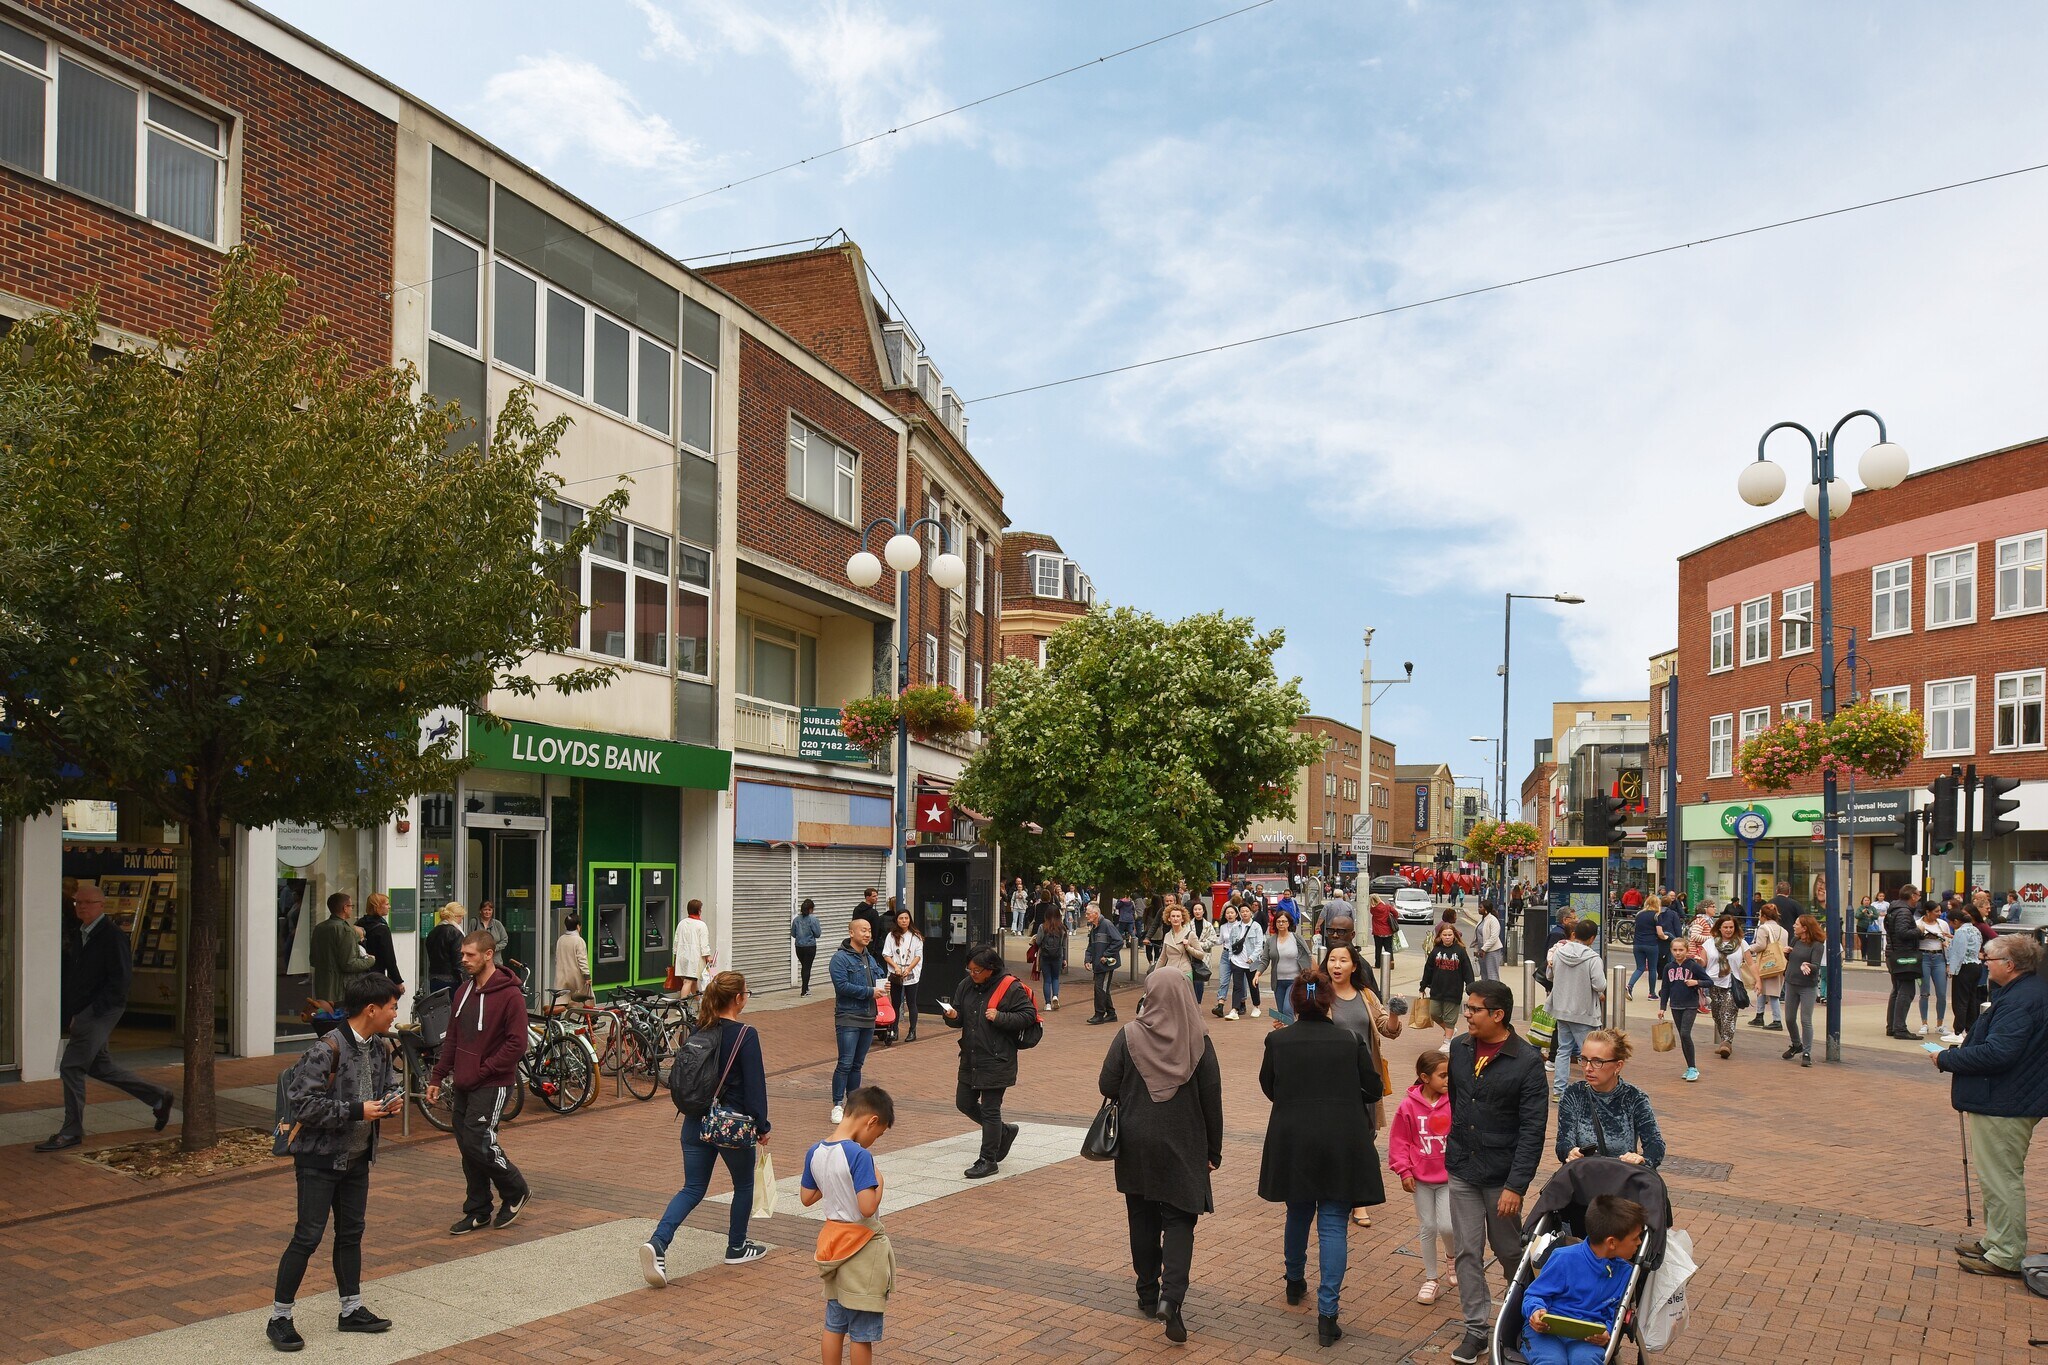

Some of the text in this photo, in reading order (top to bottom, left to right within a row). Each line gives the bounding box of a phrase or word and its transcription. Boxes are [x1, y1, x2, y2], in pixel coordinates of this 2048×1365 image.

[801, 741, 818, 749] 020
[821, 742, 842, 750] 7182
[512, 734, 662, 775] LLOYDS BANK
[800, 749, 822, 757] CBRE
[1877, 801, 1898, 809] House
[1418, 796, 1426, 828] Travelodge
[1858, 814, 1887, 823] Clarence
[1260, 830, 1294, 843] wilko
[123, 855, 142, 869] PAY
[1417, 1115, 1429, 1135] I
[1419, 1135, 1448, 1155] NY
